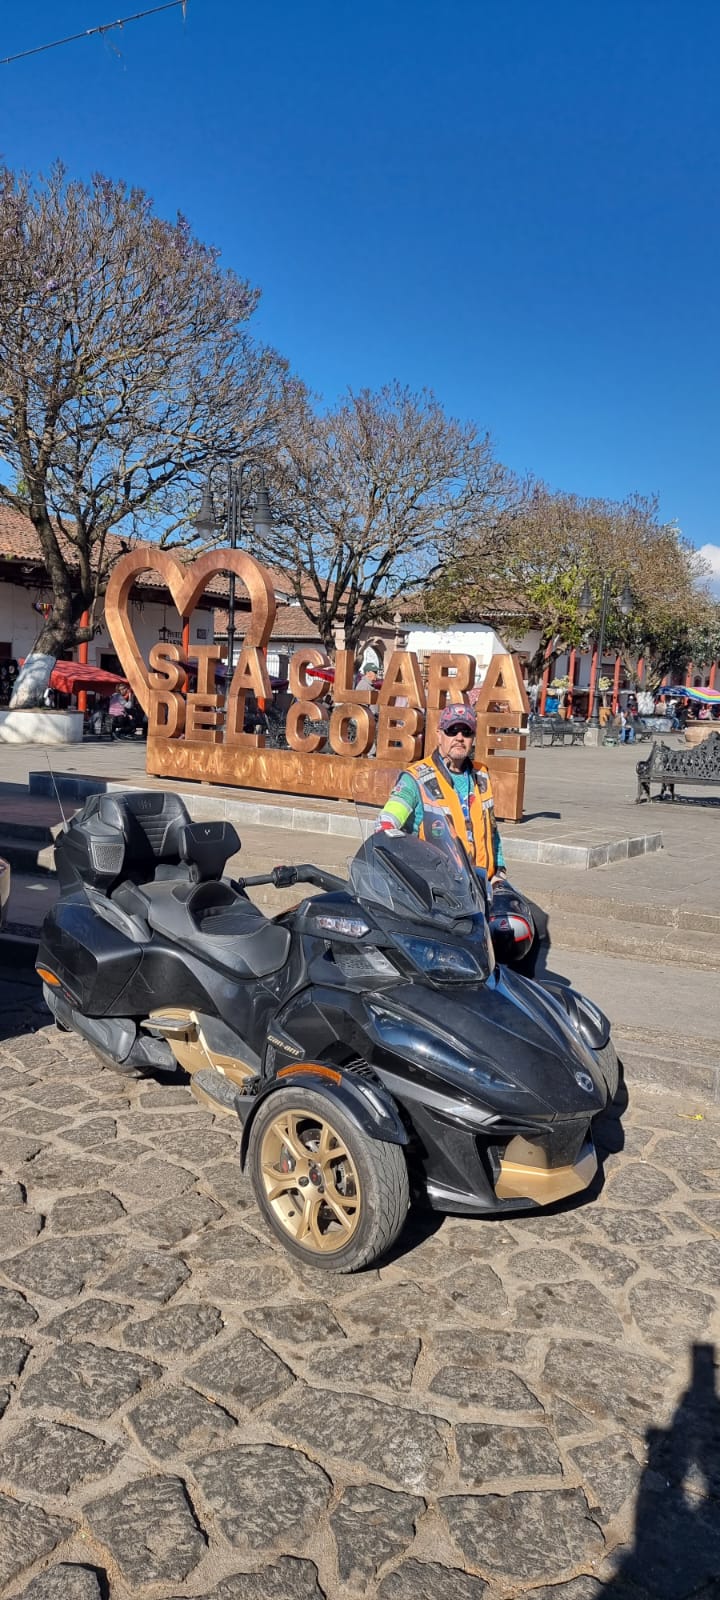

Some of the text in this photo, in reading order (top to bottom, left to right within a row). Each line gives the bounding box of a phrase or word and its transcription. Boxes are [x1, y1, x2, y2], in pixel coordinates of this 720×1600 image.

[148, 643, 530, 713] STA CLARA
[147, 689, 266, 748] DEL
[266, 1034, 300, 1056] can-am
